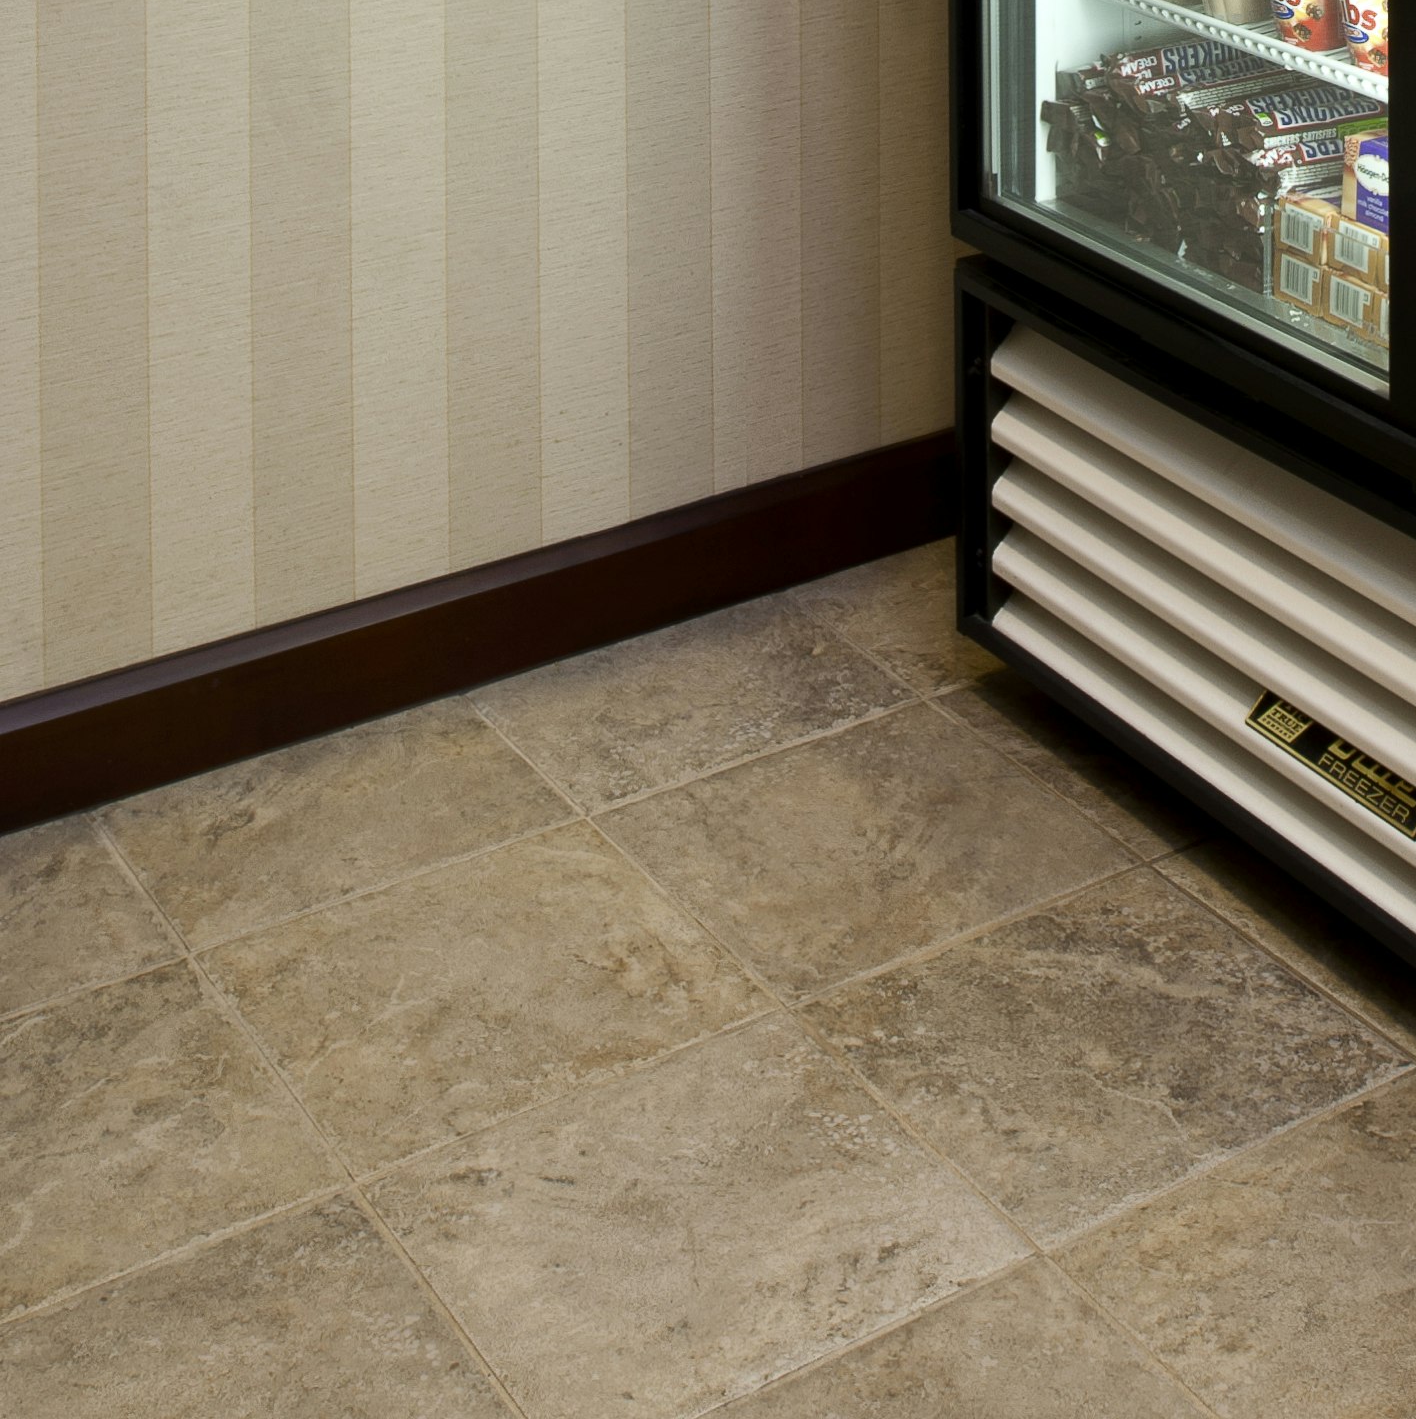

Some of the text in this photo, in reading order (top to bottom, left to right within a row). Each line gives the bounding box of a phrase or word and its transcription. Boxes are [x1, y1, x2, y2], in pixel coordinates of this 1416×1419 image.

[1120, 55, 1158, 77] CREAM
[1139, 76, 1176, 95] CREAM
[1302, 128, 1338, 142] SATISFIES
[1317, 752, 1412, 825] FREEZER
